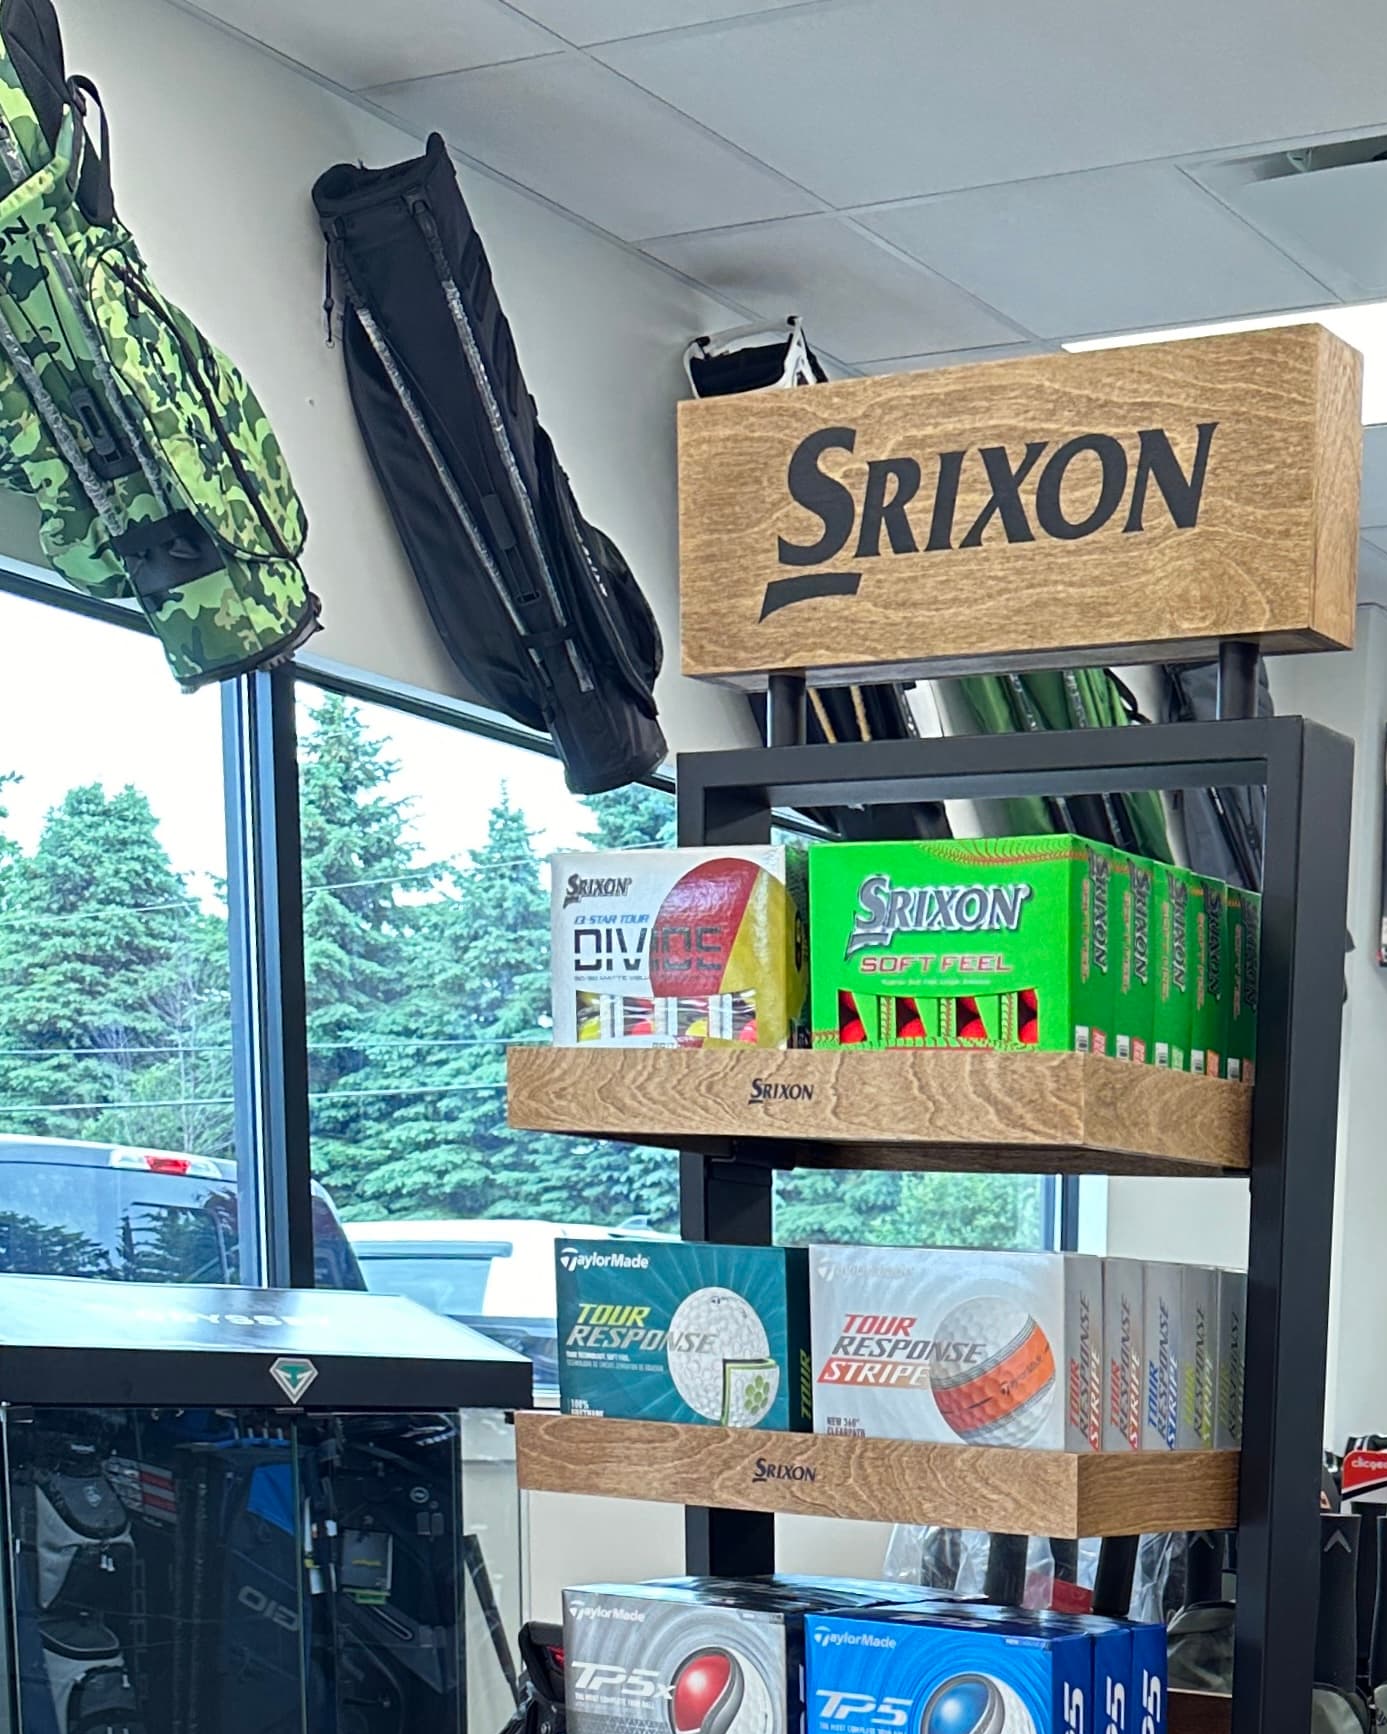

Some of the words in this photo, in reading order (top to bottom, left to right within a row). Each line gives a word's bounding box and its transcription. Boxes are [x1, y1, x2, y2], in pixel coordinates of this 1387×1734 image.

[770, 421, 1220, 568] SRIXON
[850, 873, 1032, 937] SRIXON
[574, 926, 722, 971] DIVIDE
[860, 954, 935, 973] SOFT
[940, 952, 1014, 973] FEEL
[750, 1078, 814, 1102] SRIXON
[560, 1247, 649, 1271] TaylorMade
[577, 1303, 651, 1327] TOUR
[843, 1314, 917, 1336] TOUR
[566, 1325, 720, 1354] RESPONSE
[832, 1336, 987, 1364] RESPONSE
[823, 1360, 930, 1386] STRIPE
[751, 1458, 816, 1482] SRIXON
[814, 1625, 897, 1649] TaylorMade
[571, 1661, 676, 1699] TP5x
[816, 1689, 914, 1726] TP5
